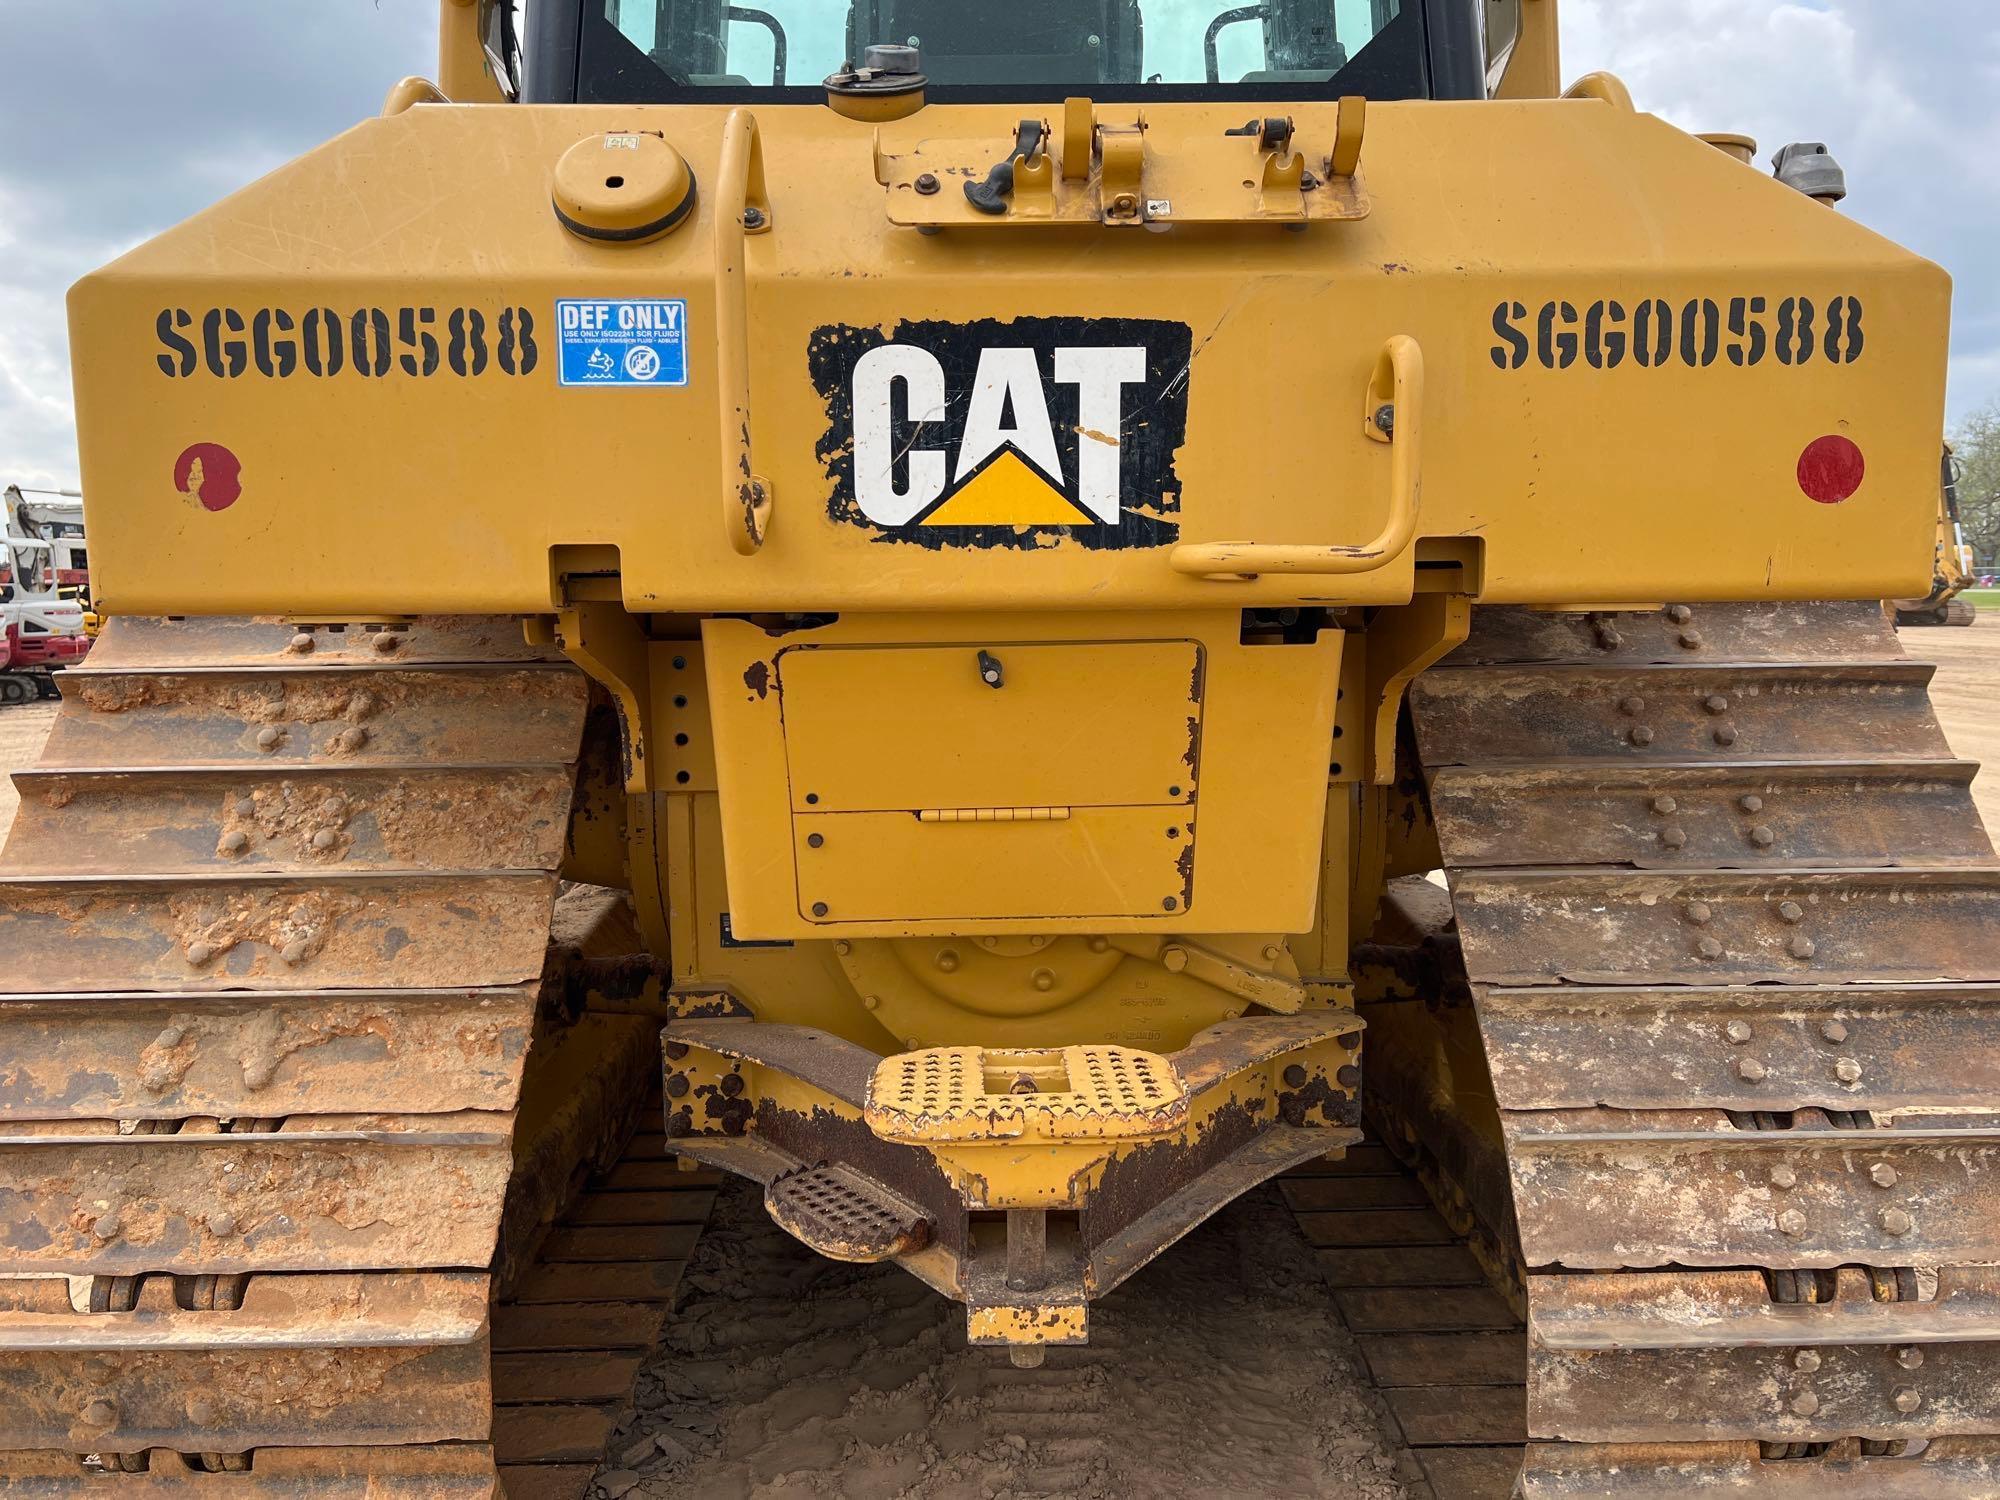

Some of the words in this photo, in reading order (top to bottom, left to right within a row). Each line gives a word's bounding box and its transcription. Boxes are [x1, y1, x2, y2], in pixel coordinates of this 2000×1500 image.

[156, 307, 538, 378] SGG00588
[564, 305, 609, 330] DEF
[618, 305, 679, 330] ONLY
[564, 330, 579, 338] USE
[580, 330, 600, 338] ONLY
[601, 330, 633, 338] ISO22241
[636, 330, 652, 338] SCR
[653, 330, 679, 338] FLUIDS
[1490, 296, 1864, 369] SGG00588
[852, 344, 1147, 526] CAT
